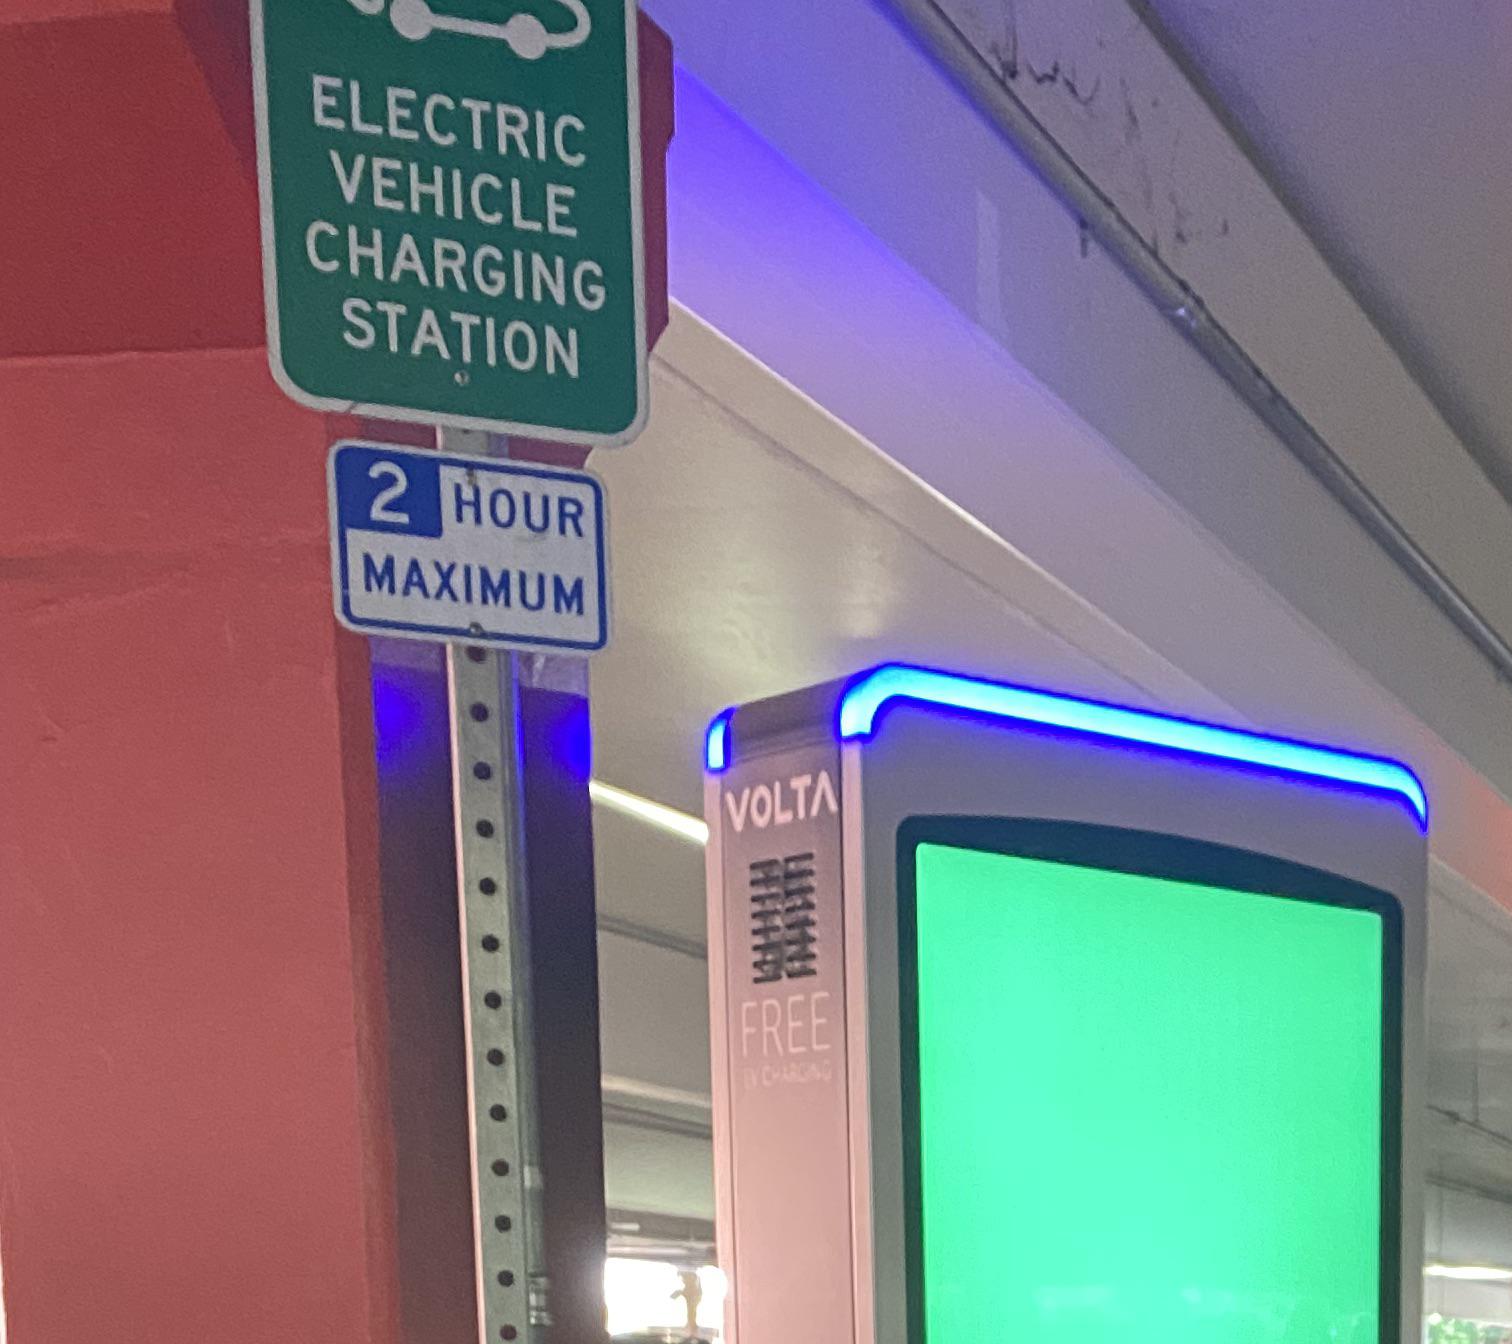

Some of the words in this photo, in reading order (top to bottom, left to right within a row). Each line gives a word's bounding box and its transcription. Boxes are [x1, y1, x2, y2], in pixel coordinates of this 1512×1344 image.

[312, 75, 586, 167] ELECTRIC
[329, 150, 577, 236] VEHICLE
[306, 221, 606, 310] CHARGING
[342, 298, 579, 377] STATION
[369, 460, 410, 524] 2
[454, 484, 584, 537] HOUR
[362, 552, 584, 615] MAXIMUM
[726, 770, 838, 832] VOLTA
[742, 992, 831, 1056] FREE
